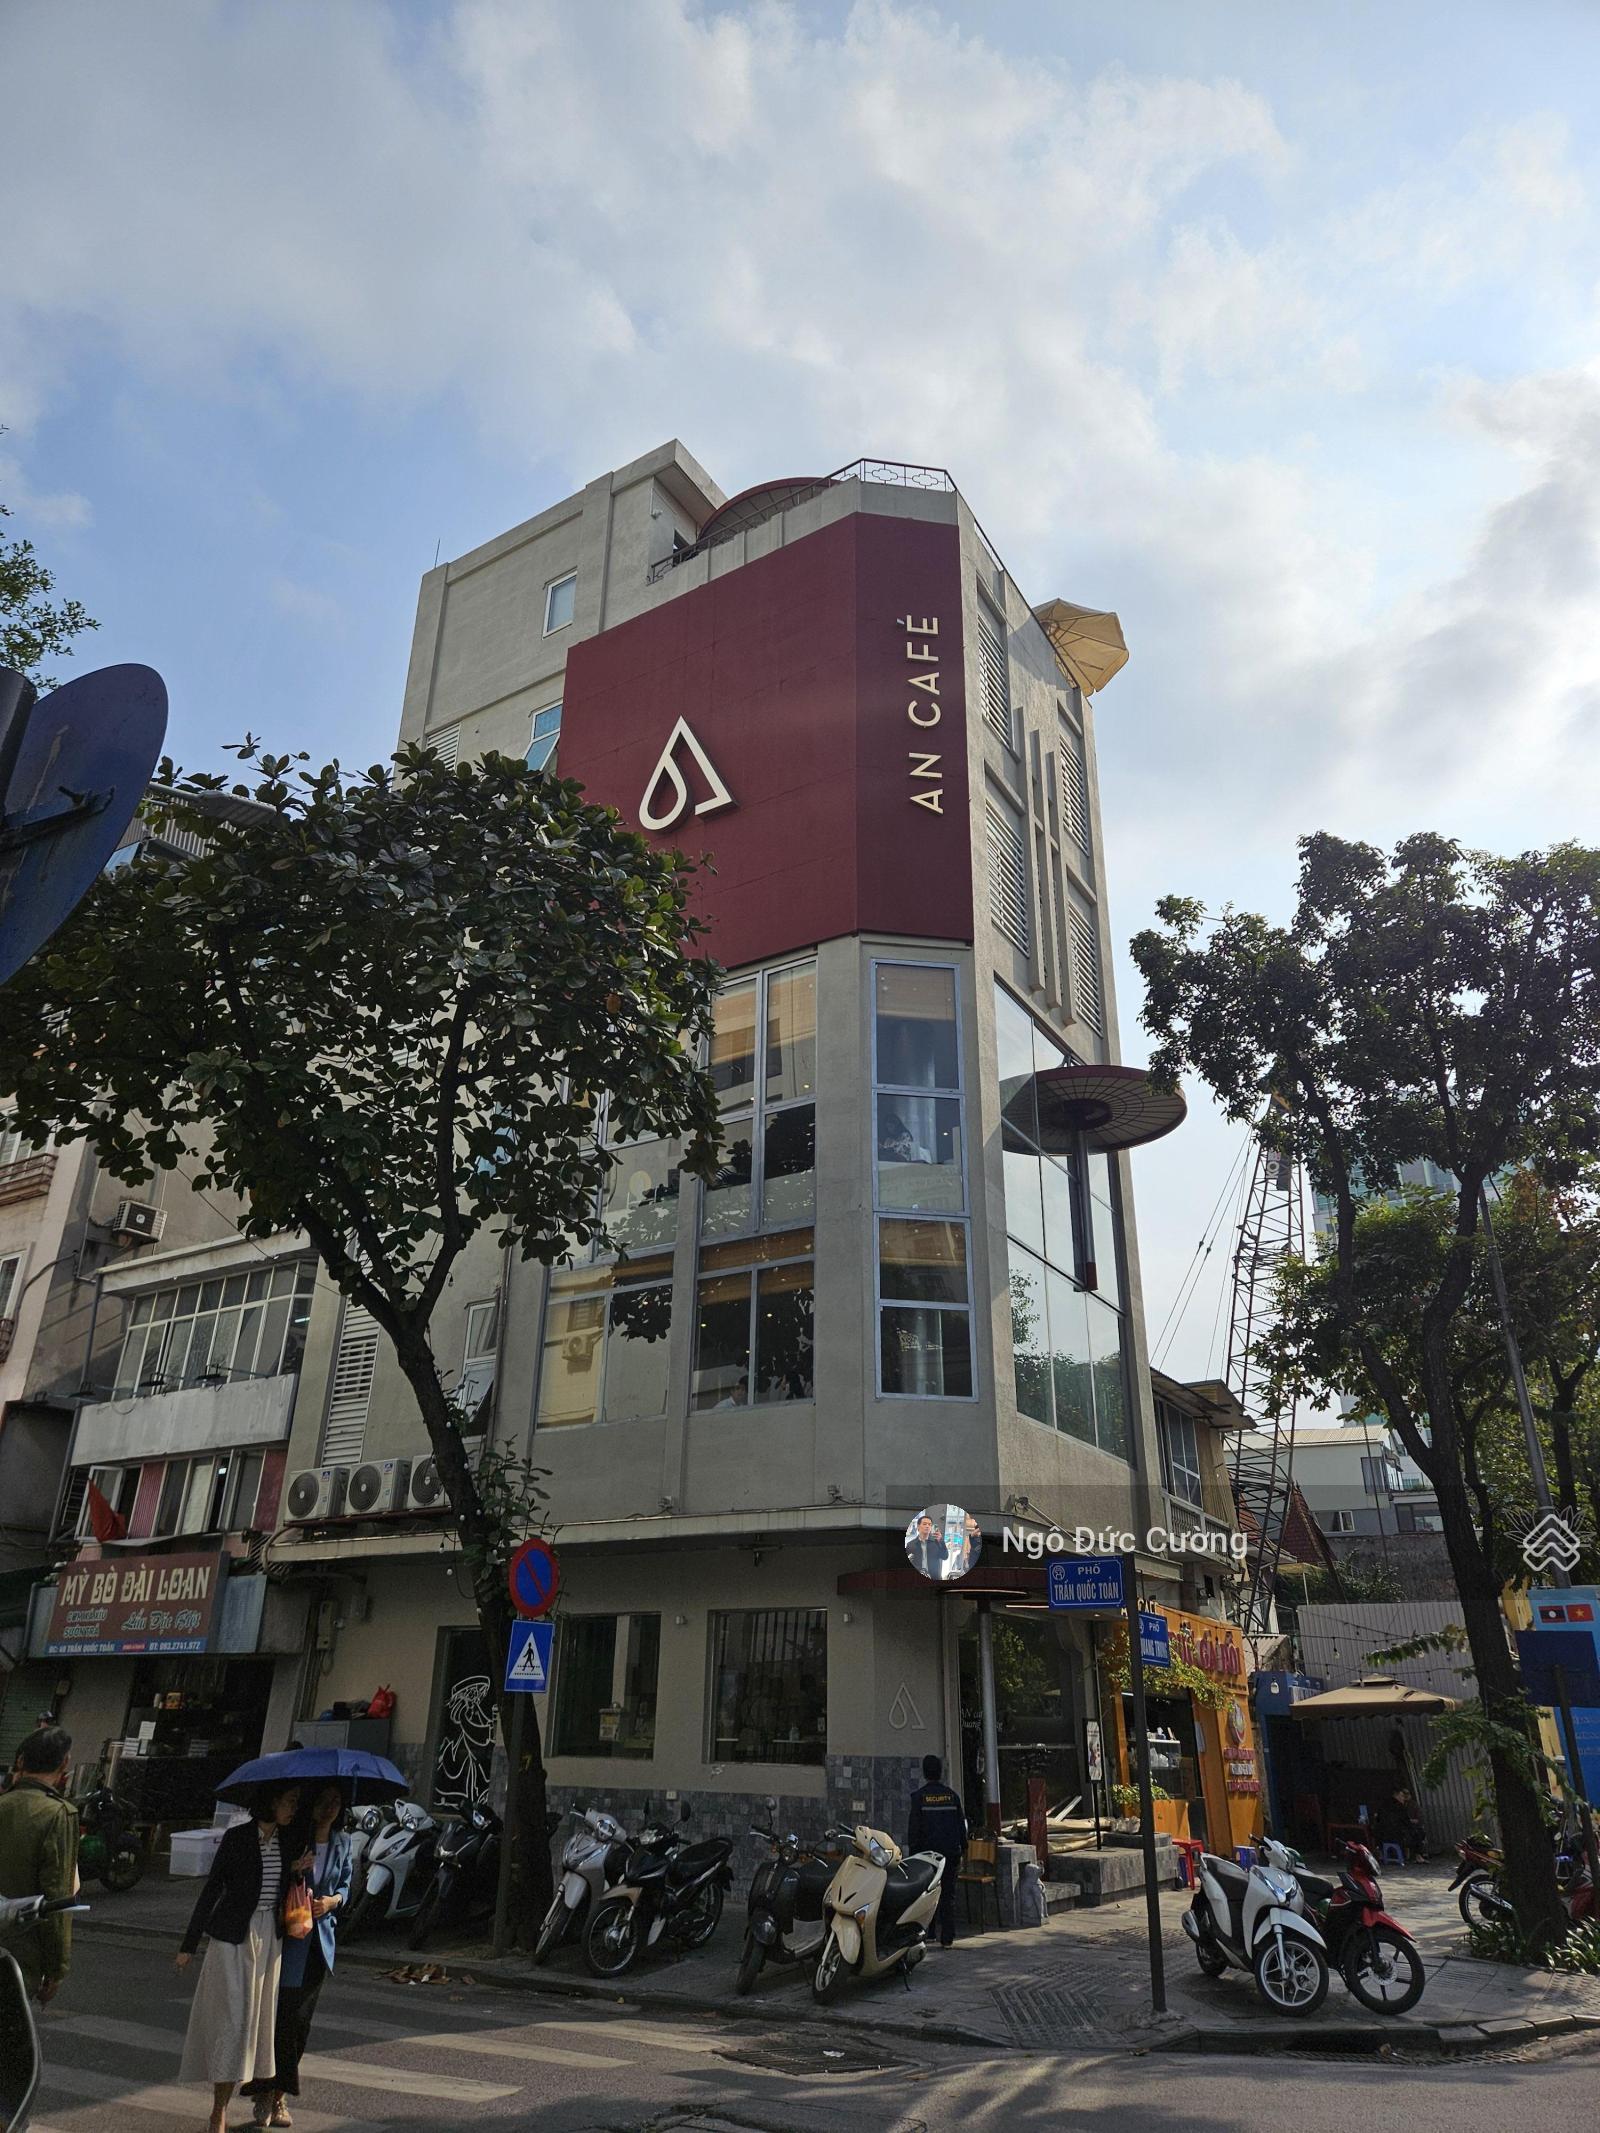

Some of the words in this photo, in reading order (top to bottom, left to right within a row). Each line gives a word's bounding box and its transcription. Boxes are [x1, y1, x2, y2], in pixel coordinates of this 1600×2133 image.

[897, 614, 942, 728] CAFÉ
[909, 752, 944, 815] AN
[90, 1564, 118, 1605] BÒ
[120, 1562, 155, 1603] ĐÀI
[156, 1566, 211, 1601] LOAN
[1077, 1562, 1101, 1576] PHỐ
[1076, 1578, 1097, 1602] QUỐC
[925, 1794, 952, 1802] SECURITY
